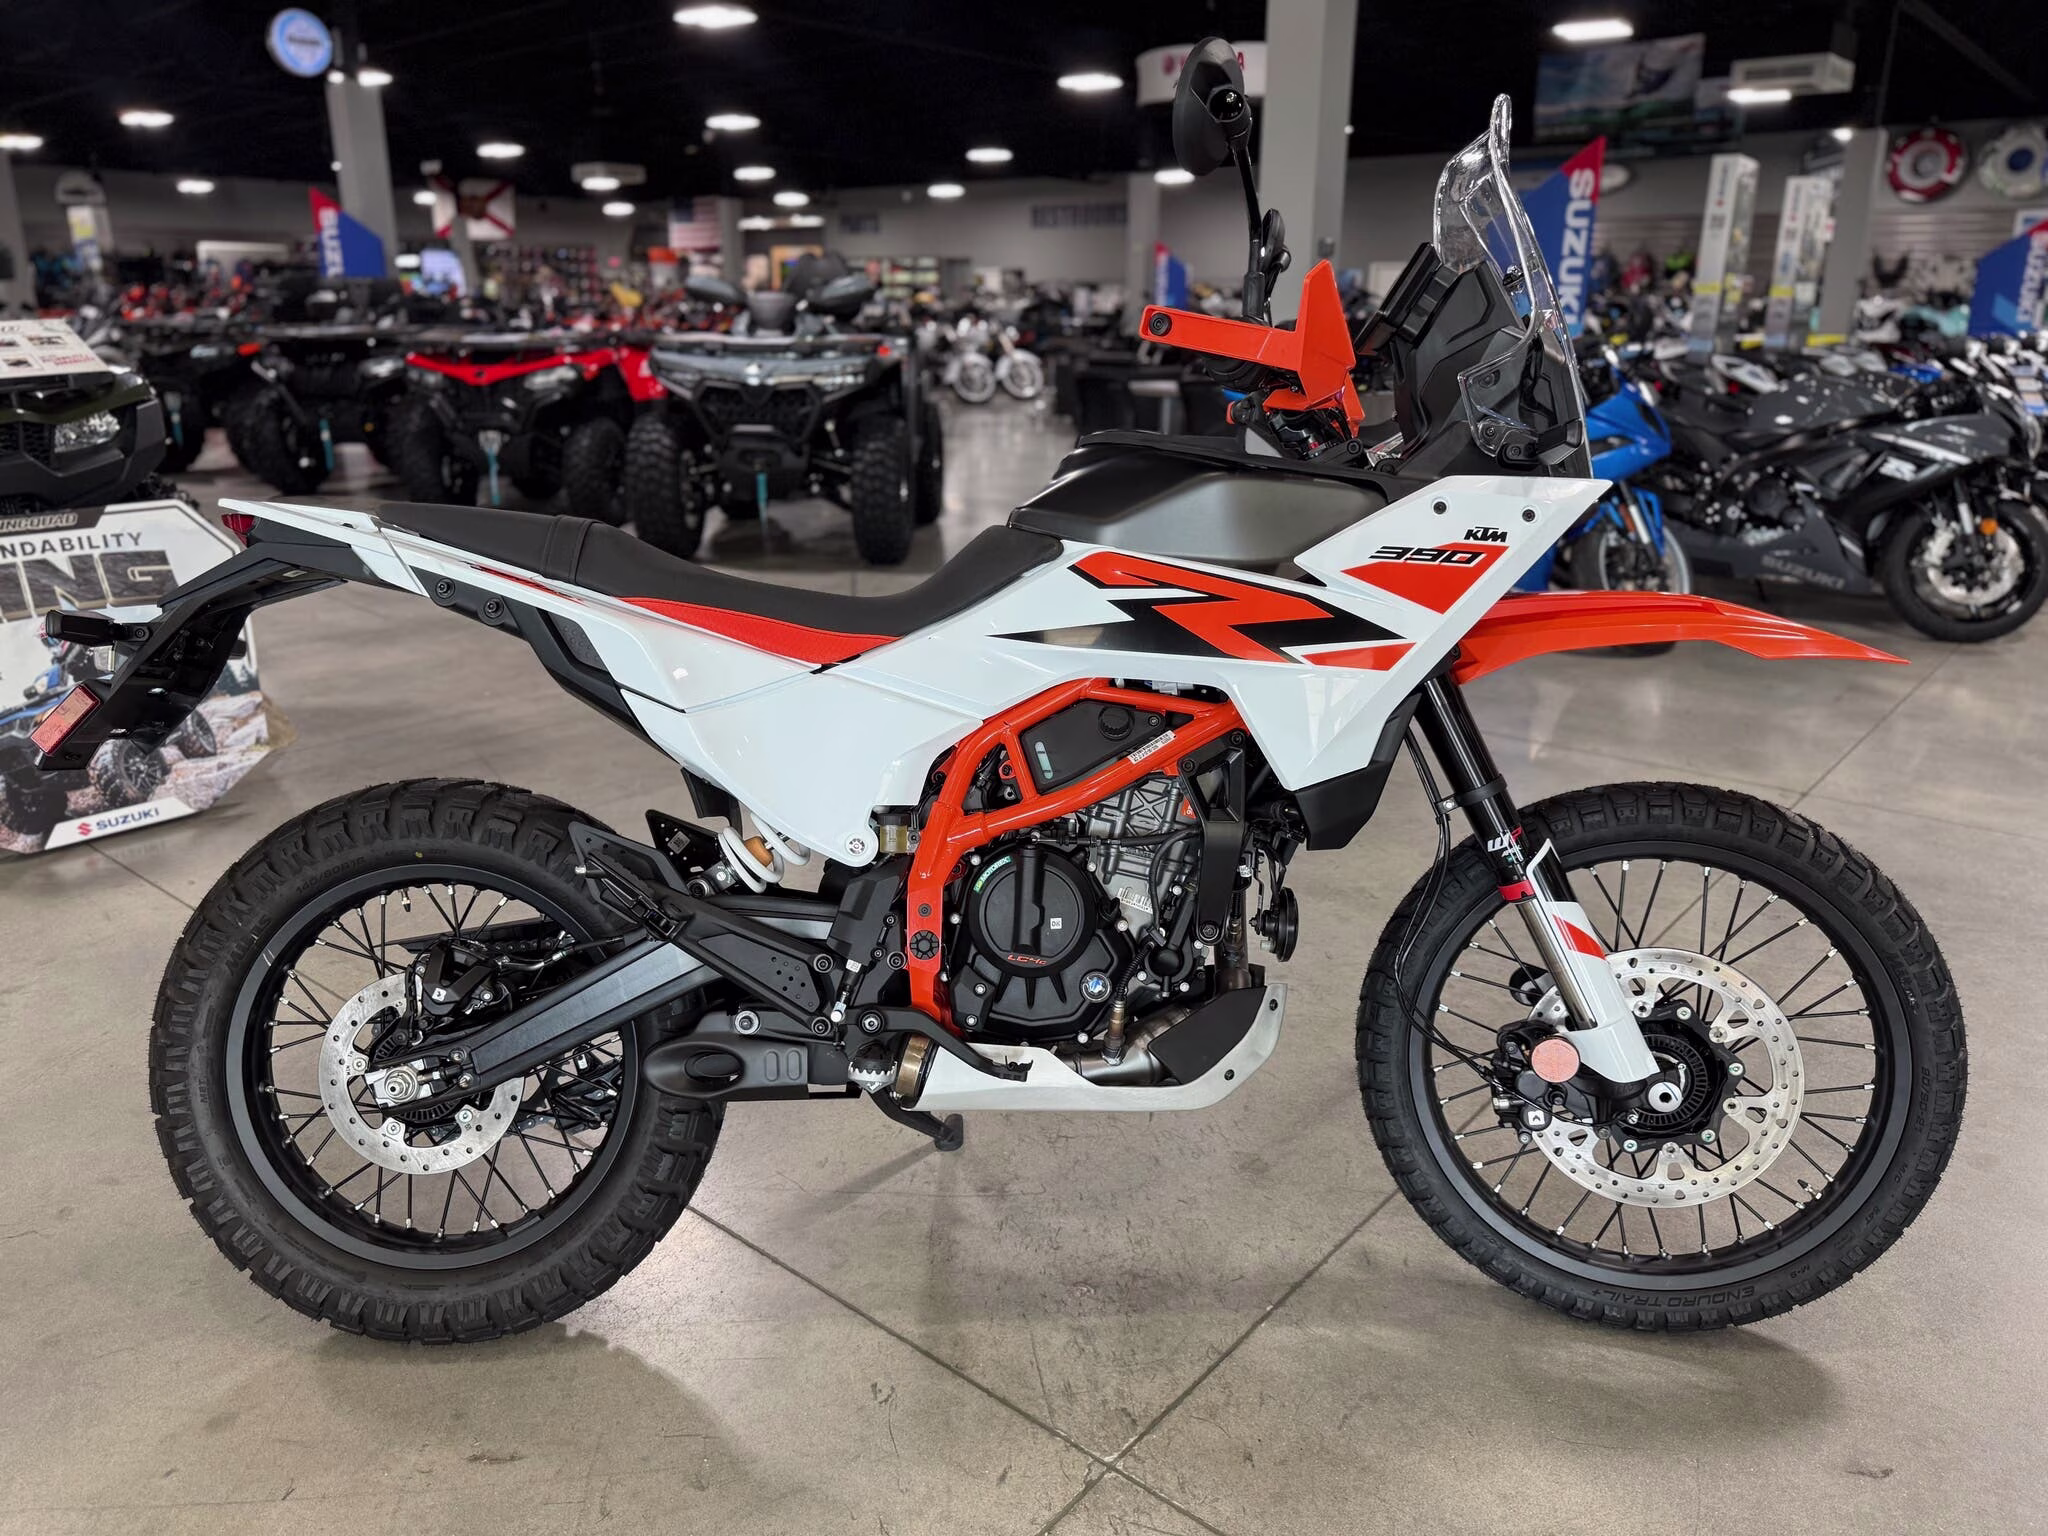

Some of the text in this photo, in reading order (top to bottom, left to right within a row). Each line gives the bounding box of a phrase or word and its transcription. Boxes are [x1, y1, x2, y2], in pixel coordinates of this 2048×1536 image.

[1557, 167, 1595, 324] SUZUKI
[0, 531, 143, 559] NDABILITY
[1463, 526, 1508, 543] KTM
[1368, 545, 1486, 565] 390
[0, 550, 181, 623] ING
[96, 807, 160, 830] SUZUKI
[980, 856, 1010, 882] MOTOREX
[1591, 1284, 1755, 1307] ENDURO TRAIL+
